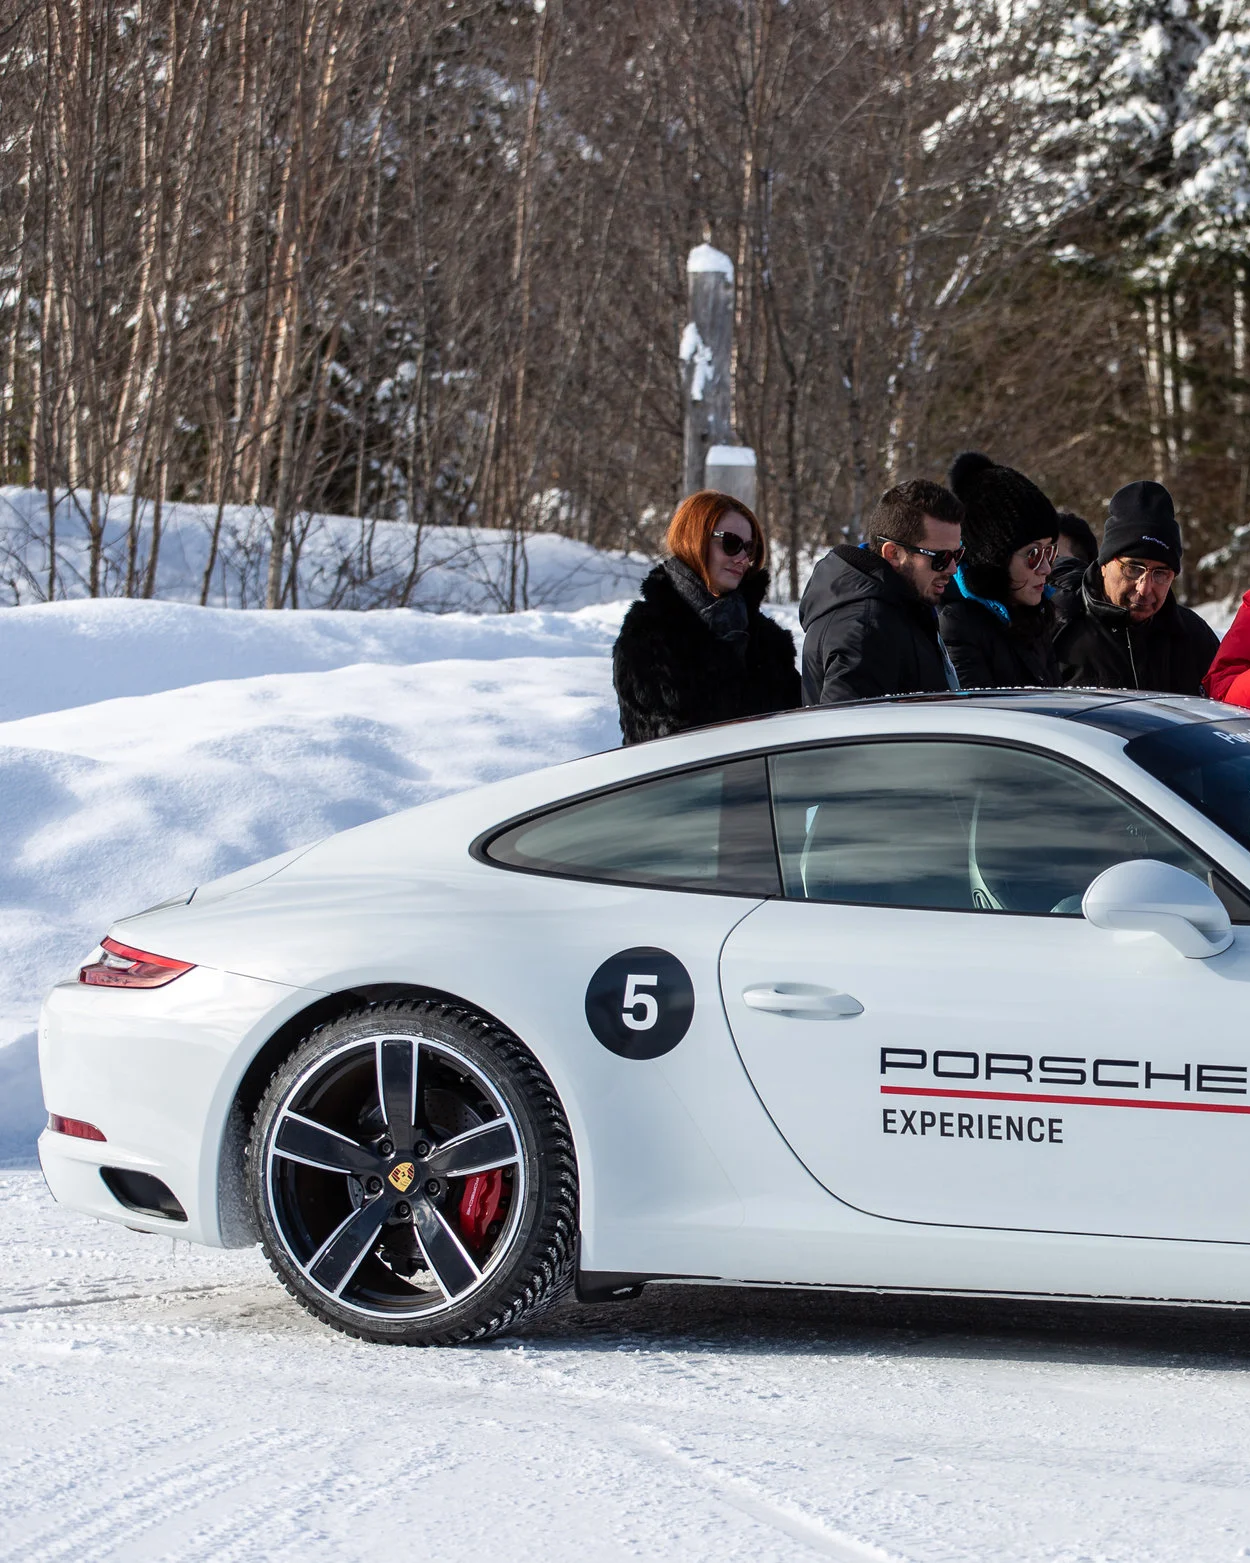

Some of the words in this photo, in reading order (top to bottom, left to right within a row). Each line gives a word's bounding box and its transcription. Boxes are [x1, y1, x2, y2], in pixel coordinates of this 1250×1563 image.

[622, 975, 657, 1030] 5
[881, 1047, 1248, 1095] PORSCHE
[882, 1109, 1064, 1143] EXPERIENCE
